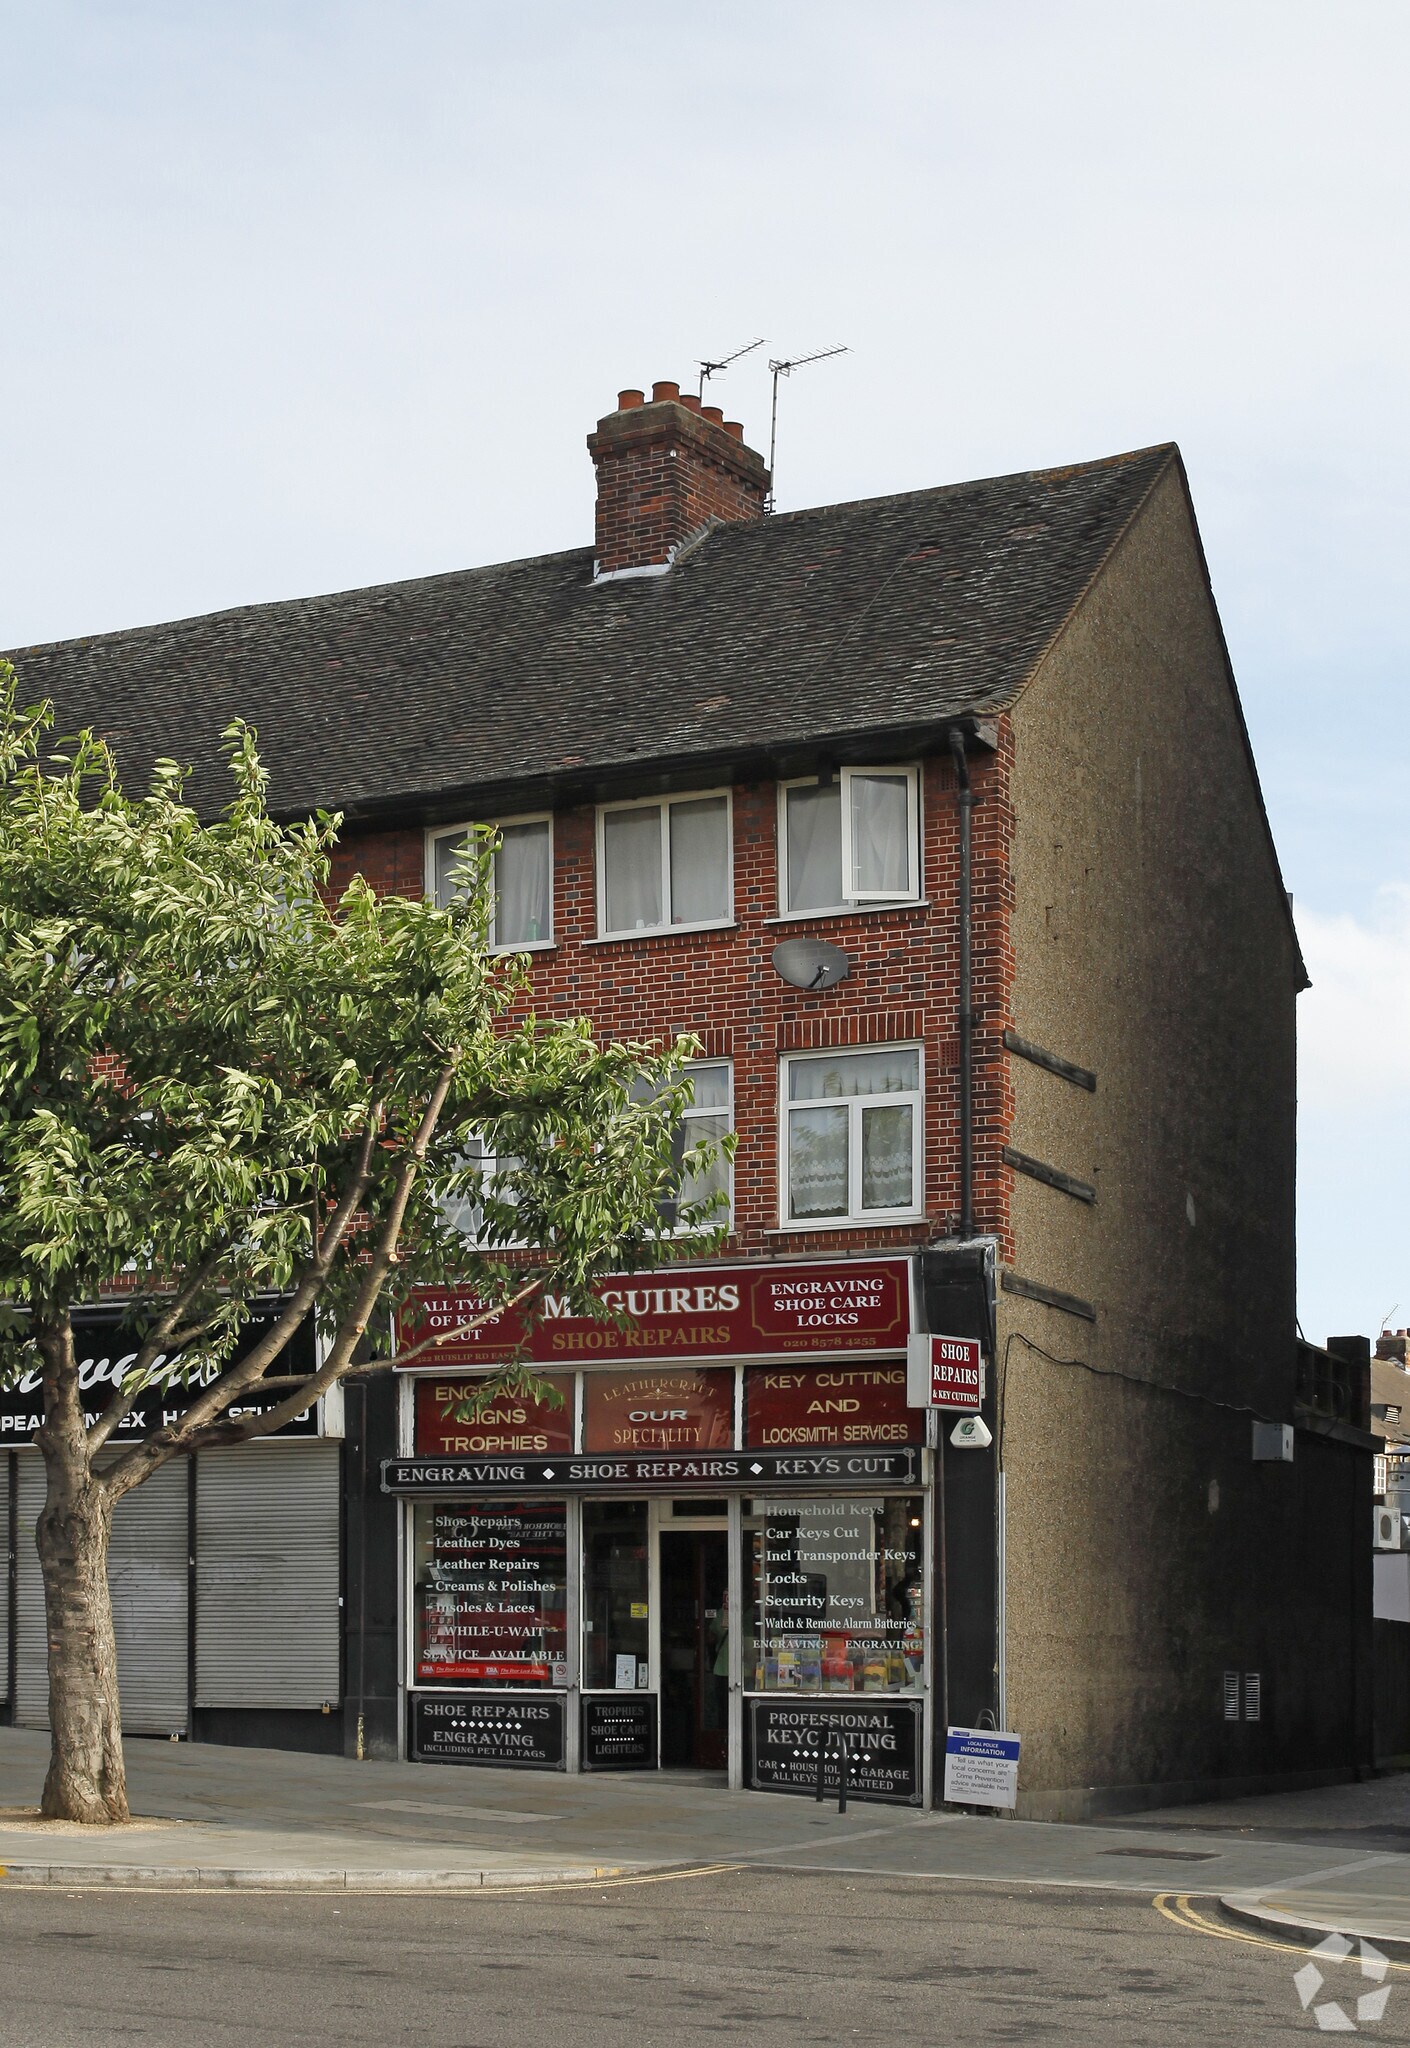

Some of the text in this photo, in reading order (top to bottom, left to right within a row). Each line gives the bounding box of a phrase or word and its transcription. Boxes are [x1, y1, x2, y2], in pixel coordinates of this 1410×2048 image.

[770, 1279, 884, 1296] ENGRAVING
[422, 1300, 453, 1312] ALL
[543, 1284, 740, 1319] MGUIRES
[774, 1295, 881, 1311] SHOE CARE
[429, 1315, 452, 1327] OF
[797, 1312, 859, 1326] LOCKS
[552, 1325, 731, 1350] SHOE REPAIRS
[783, 1337, 877, 1348] 020 8578 4255
[941, 1342, 970, 1362] SHOE
[765, 1370, 905, 1389] KEY CUTTING
[933, 1364, 978, 1385] REPAIRS
[603, 1378, 717, 1401] LEATHERCRAFT
[932, 1389, 978, 1403] & KEY CUTTING
[806, 1399, 860, 1414] AND
[628, 1409, 688, 1422] OUR
[613, 1427, 702, 1443] SPECIALITY
[762, 1424, 908, 1444] LOCKSMITH SERVICES
[440, 1435, 548, 1452] TROPHIES
[396, 1457, 895, 1482] ENGRAVING SHOE REPAIRS KEYS CUT
[766, 1504, 885, 1517] Household Keys
[435, 1515, 521, 1529] Shoe Repairs
[766, 1526, 860, 1541] Car Keys Cut
[435, 1537, 520, 1550] Leather Dyes
[766, 1548, 916, 1564] Incl Transponder Keys
[435, 1558, 540, 1572] Leather Repairs
[765, 1572, 807, 1584] Locks
[435, 1580, 556, 1592] Creams & Polishes
[436, 1602, 535, 1613] Insoles & Laces
[765, 1594, 864, 1609] Security Keys
[765, 1617, 917, 1630] Watch & Remote Alarm Batteries
[443, 1626, 545, 1637] WHILE-U-WAIT
[753, 1639, 923, 1650] ENGRAVING! ENGRAVING!
[423, 1649, 565, 1661] SERVICE AVAILABLE
[423, 1704, 550, 1720] SHOE REPAIRS
[595, 1706, 644, 1716] TROPHIES
[769, 1712, 894, 1729] PROFESSIONAL
[591, 1724, 648, 1735] SHOE CARE
[433, 1730, 535, 1747] ENGRAVING
[423, 1744, 474, 1754] INCLUDING
[477, 1747, 497, 1755] PET
[595, 1744, 644, 1754] LIGHTERS
[960, 1746, 1006, 1756] INFORMATION
[758, 1759, 778, 1770] CAR
[860, 1767, 910, 1780] GARAGE
[772, 1771, 791, 1781] ALL
[792, 1772, 818, 1784] KEYS
[974, 1775, 1005, 1783] Prevention
